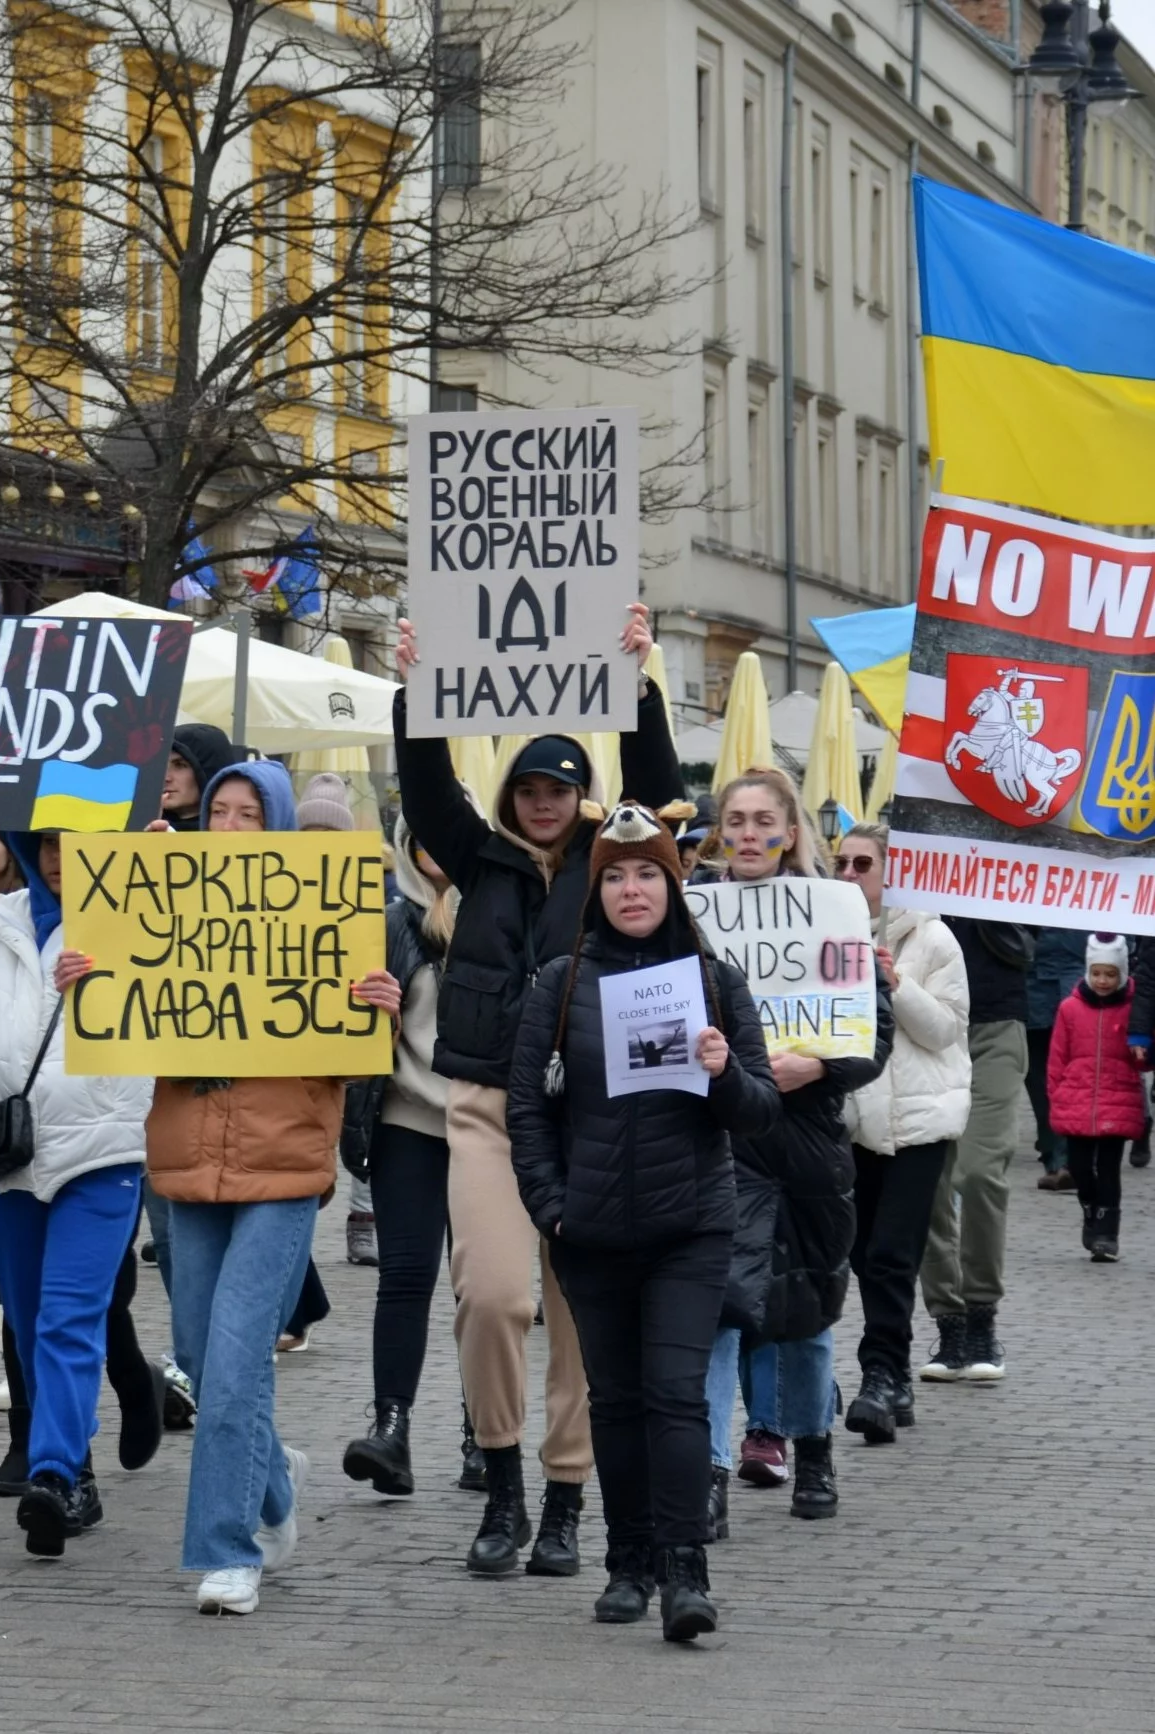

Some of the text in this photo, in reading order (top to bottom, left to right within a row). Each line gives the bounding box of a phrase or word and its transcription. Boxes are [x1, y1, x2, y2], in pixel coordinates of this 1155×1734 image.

[429, 418, 617, 474] РУССКИЙ
[430, 468, 617, 521] ВОЕННЫЙ
[430, 519, 618, 571] КОРАБЛЬ
[931, 522, 1155, 640] NO W
[435, 654, 609, 719] НАХУЙ
[76, 848, 384, 923] ХАРКІВ-ЦЕ
[887, 846, 1039, 904] ТРИМАЙТЕСЯ
[1041, 865, 1120, 912] БРАТИ
[130, 912, 349, 978] УКРАЇНА
[725, 940, 872, 982] NDS OFF
[73, 969, 379, 1041] СЛАВА ЗСУ
[618, 999, 691, 1020] CLOSE THE SKY
[634, 982, 673, 1000] NATO
[758, 997, 855, 1040] AINE
